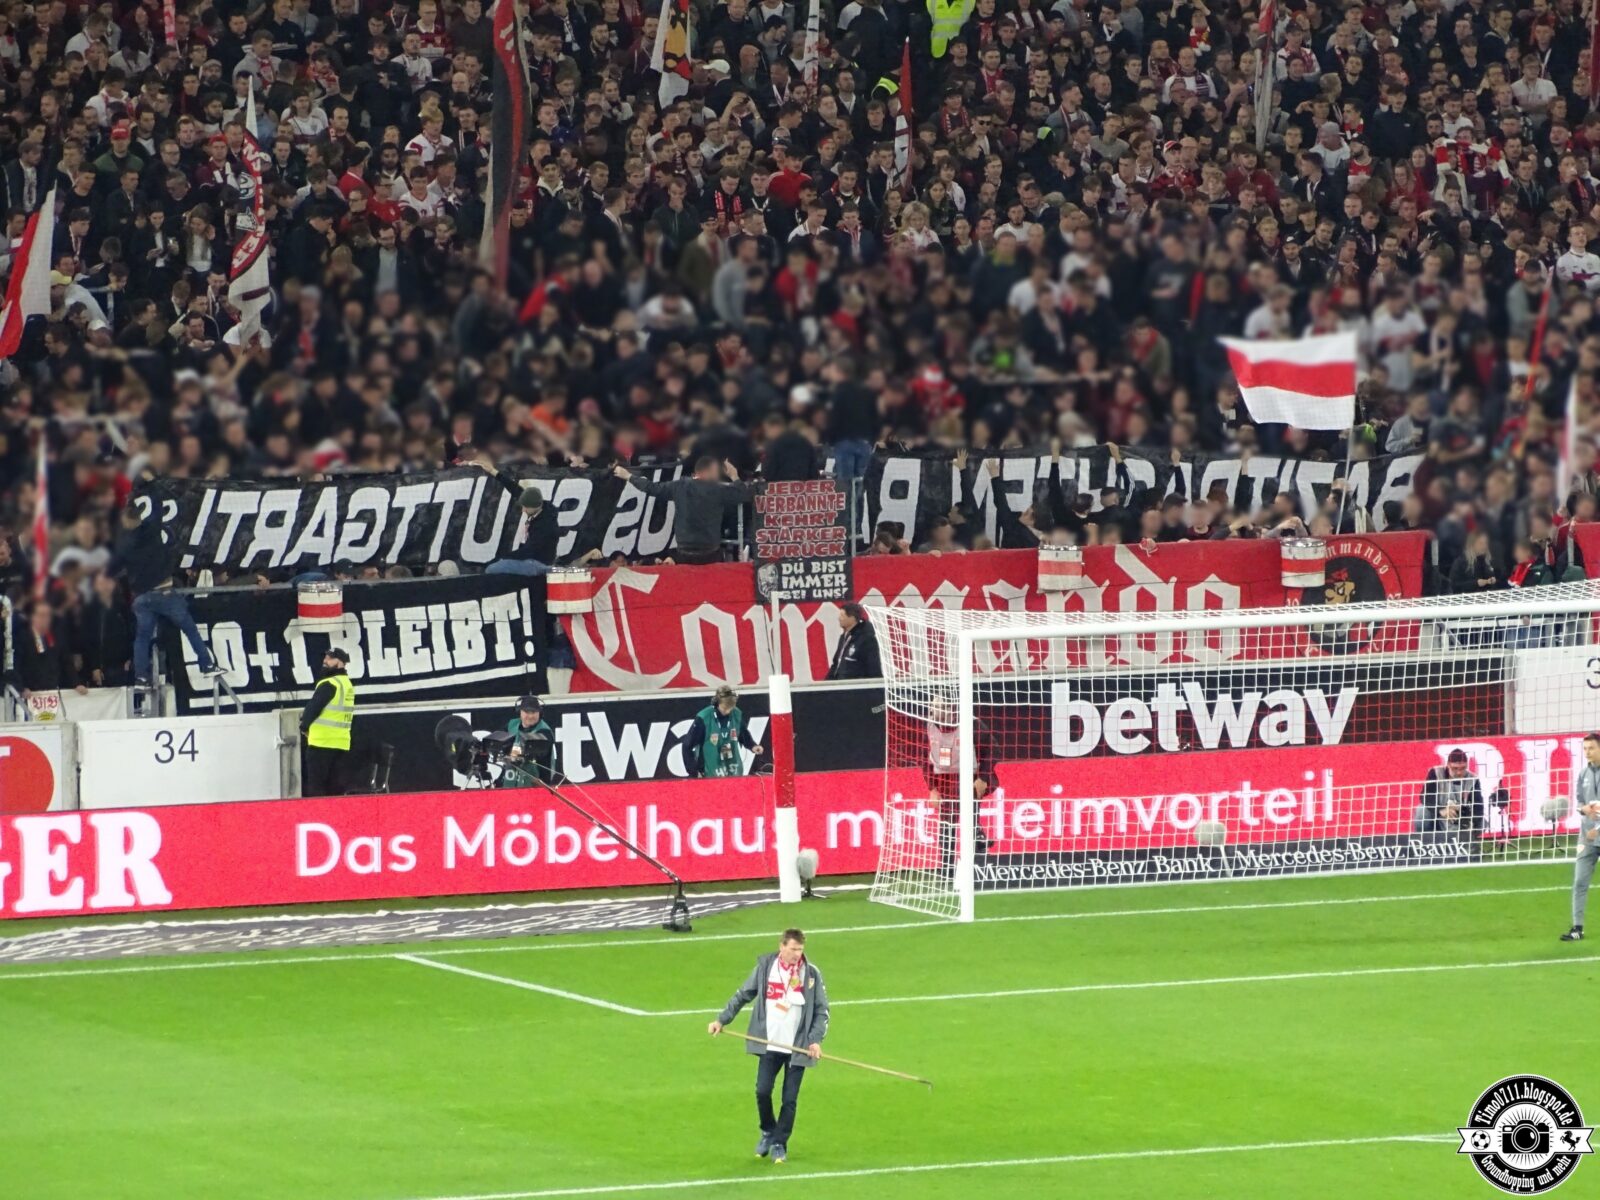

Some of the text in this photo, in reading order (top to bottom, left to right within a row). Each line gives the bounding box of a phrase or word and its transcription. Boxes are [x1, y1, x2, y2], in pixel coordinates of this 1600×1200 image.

[765, 480, 836, 495] JEDER
[755, 492, 846, 514] VERBANNTE
[764, 511, 838, 527] KEHRT
[811, 561, 846, 573] BIST
[782, 574, 847, 589] IMMER
[812, 588, 848, 600] UNS!
[1052, 682, 1359, 757] betway
[154, 729, 199, 763] 34
[296, 822, 416, 876] Das
[443, 805, 777, 869] Möbelhau
[826, 793, 937, 848] mit
[1236, 838, 1469, 868] Mercedes-Benz Bank
[973, 854, 1214, 883] Mercedes-Benz Bank
